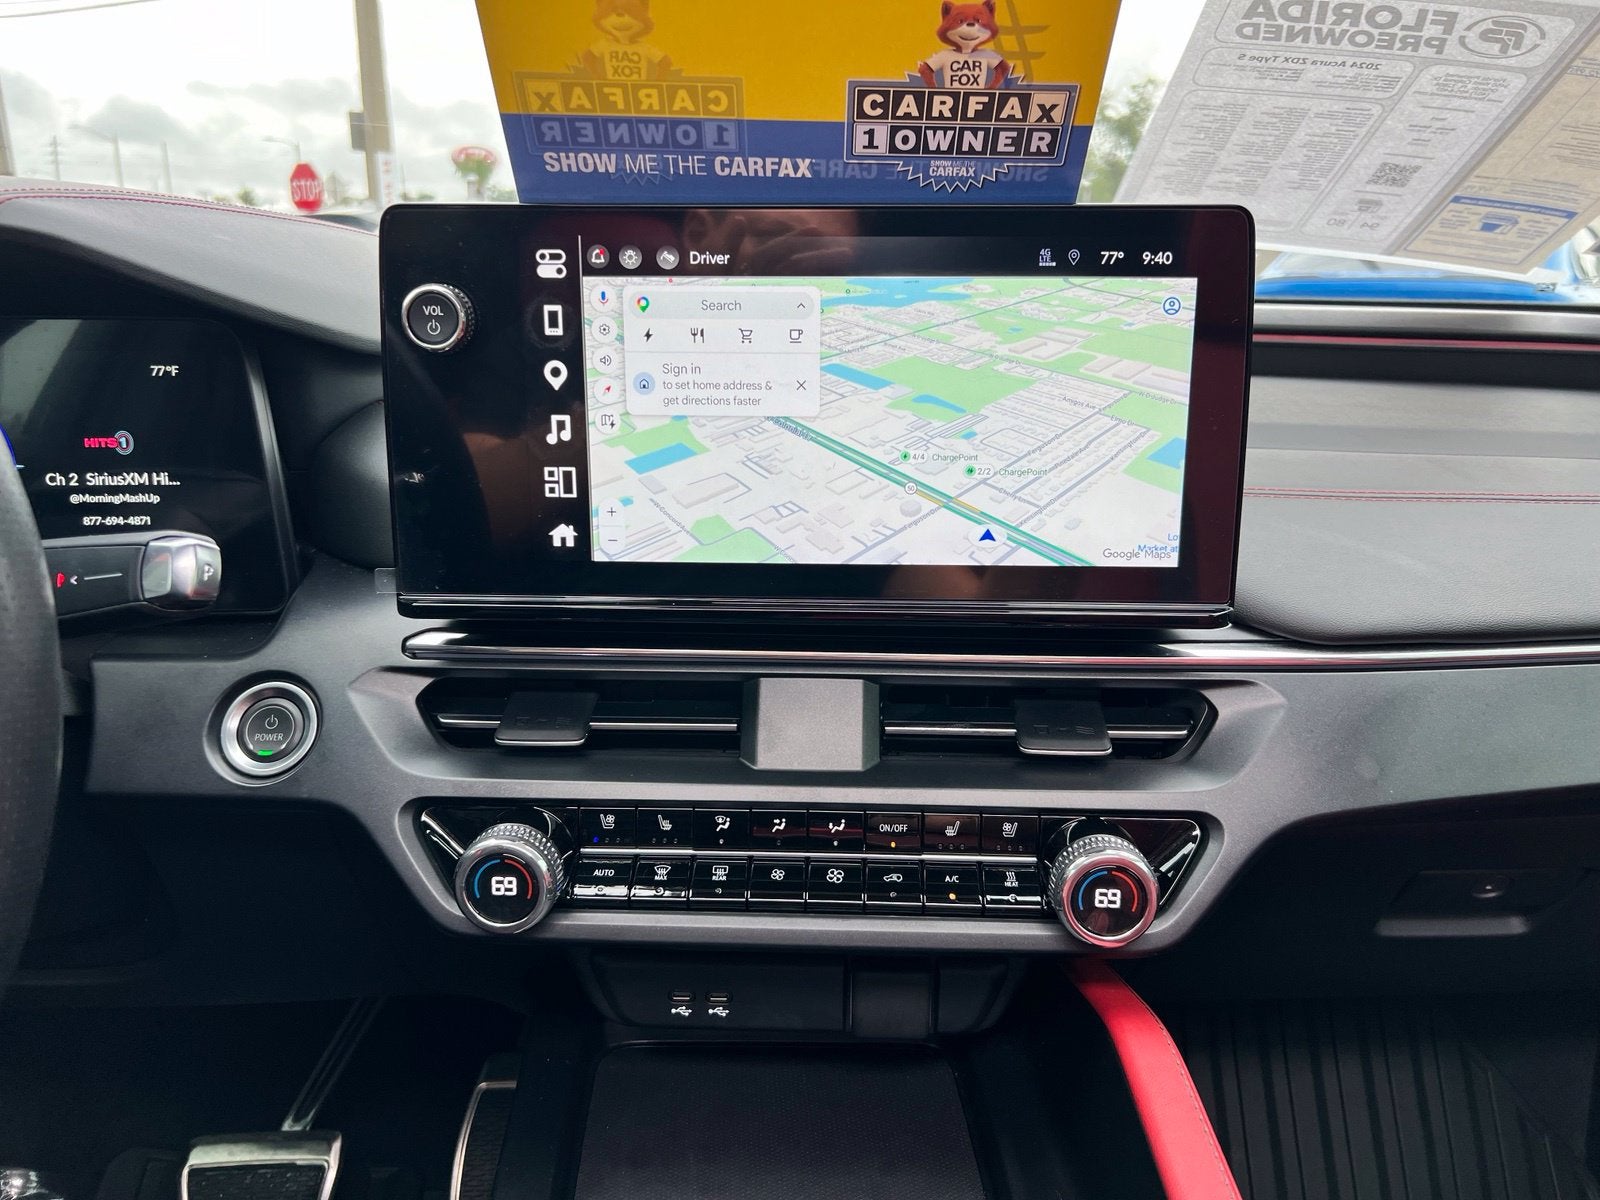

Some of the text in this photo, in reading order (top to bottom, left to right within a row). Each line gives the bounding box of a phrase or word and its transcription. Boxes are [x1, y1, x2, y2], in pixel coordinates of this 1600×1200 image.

[950, 60, 982, 73] CAR
[950, 74, 980, 87] FOX
[863, 93, 1058, 123] CARFAX
[543, 152, 811, 178] SHOW ME THE CARFAX
[929, 167, 975, 177] CARFAX
[293, 179, 322, 200] STOP
[689, 250, 731, 265] Driver
[1100, 251, 1173, 265] 77° 9:40
[423, 306, 444, 316] VOL
[701, 299, 742, 312] Search
[150, 365, 179, 377] 77°F
[662, 362, 701, 377] Sign in
[663, 380, 773, 390] to set home address &
[663, 395, 762, 407] get directions faster
[1110, 414, 1127, 425] Elmo
[1027, 432, 1063, 456] Ferguson Dr
[1110, 429, 1147, 461] Kensington Dr
[912, 452, 925, 461] 4/4
[932, 452, 979, 463] ChargePoint
[977, 467, 991, 476] 2/2
[998, 467, 1048, 478] ChargePoint
[45, 472, 66, 486] Ch
[69, 472, 79, 486] 2
[86, 472, 149, 486] SiriusXM
[906, 484, 916, 492] 50
[70, 493, 161, 506] @MorningMashUp
[1019, 497, 1058, 526] Kensington Dr
[83, 516, 151, 526] 877-694-4871
[903, 507, 940, 530] Ferguson Dr
[1102, 547, 1171, 561] Google Maps
[1137, 544, 1178, 553] Market at
[254, 732, 284, 742] POWER
[879, 823, 908, 834] ON/OFF
[593, 869, 615, 877] AUTO
[945, 875, 960, 884] A/C
[491, 876, 518, 896] 69
[1094, 888, 1122, 909] 69
